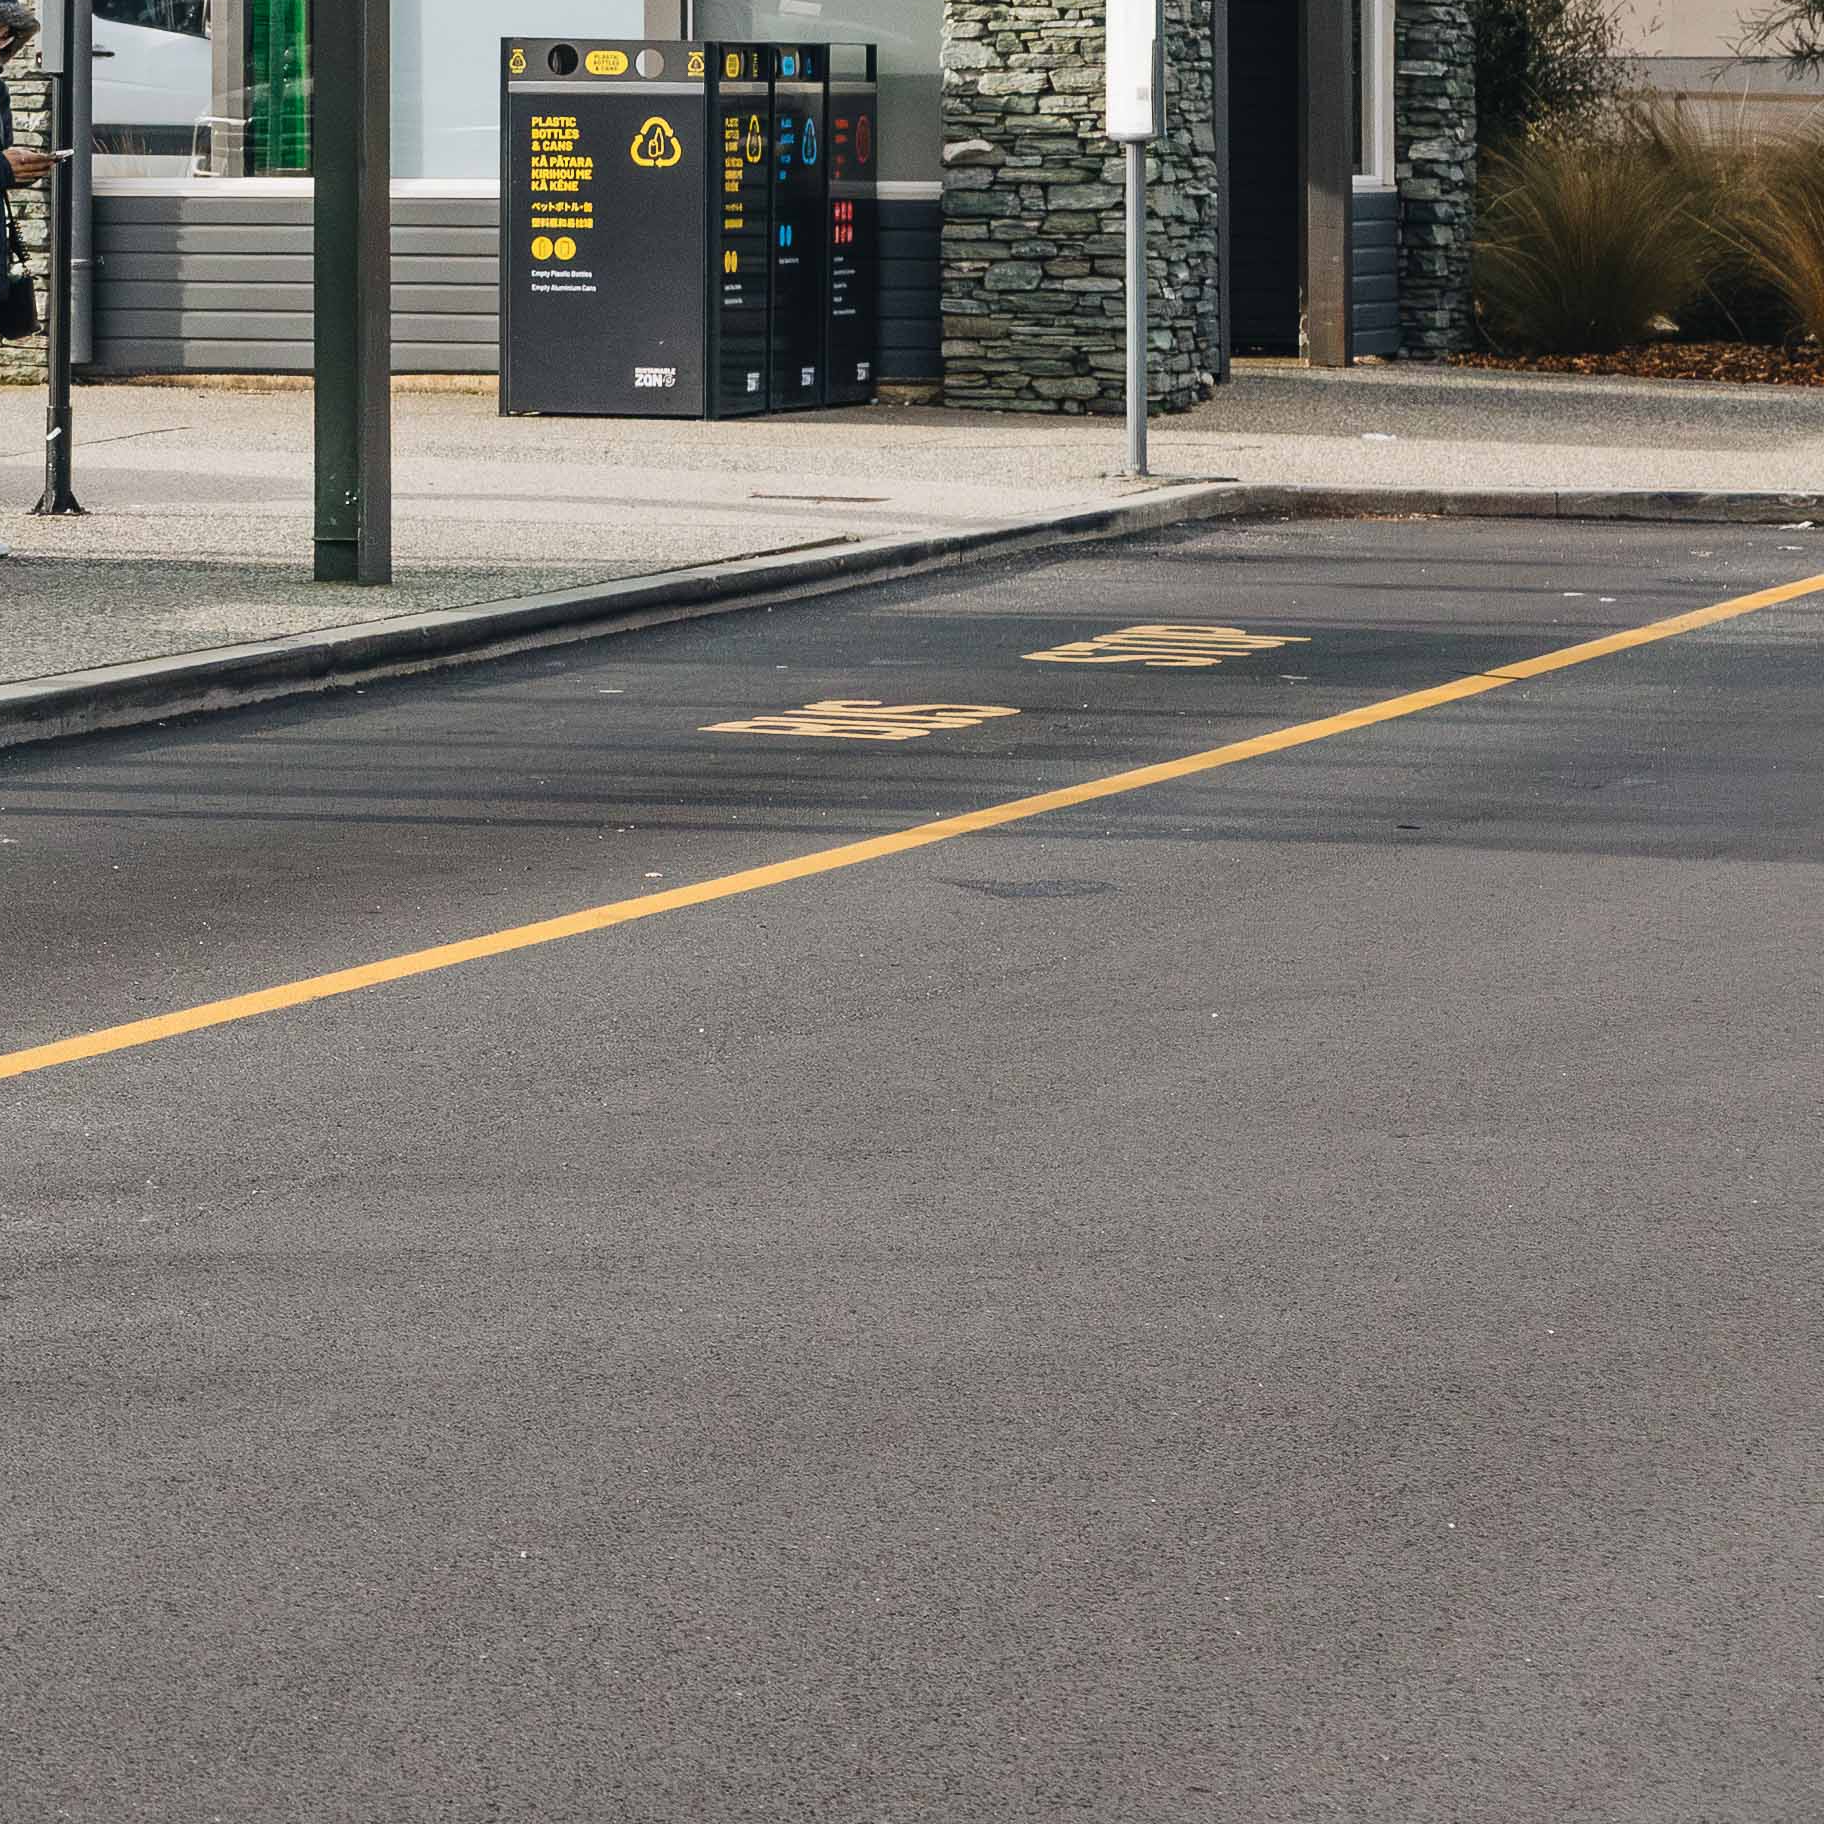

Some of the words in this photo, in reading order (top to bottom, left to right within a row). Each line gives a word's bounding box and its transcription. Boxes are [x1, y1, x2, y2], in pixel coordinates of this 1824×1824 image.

[531, 116, 576, 127] PLASTIC
[531, 129, 580, 140] BOTTLES
[531, 141, 541, 152] &
[542, 141, 573, 152] CANS
[531, 169, 575, 180] KIRIHOU
[576, 169, 593, 180] ME
[531, 270, 550, 278] Empty
[531, 284, 550, 292] Empty
[1020, 625, 1312, 666] STOP
[697, 699, 1021, 740] BUS
